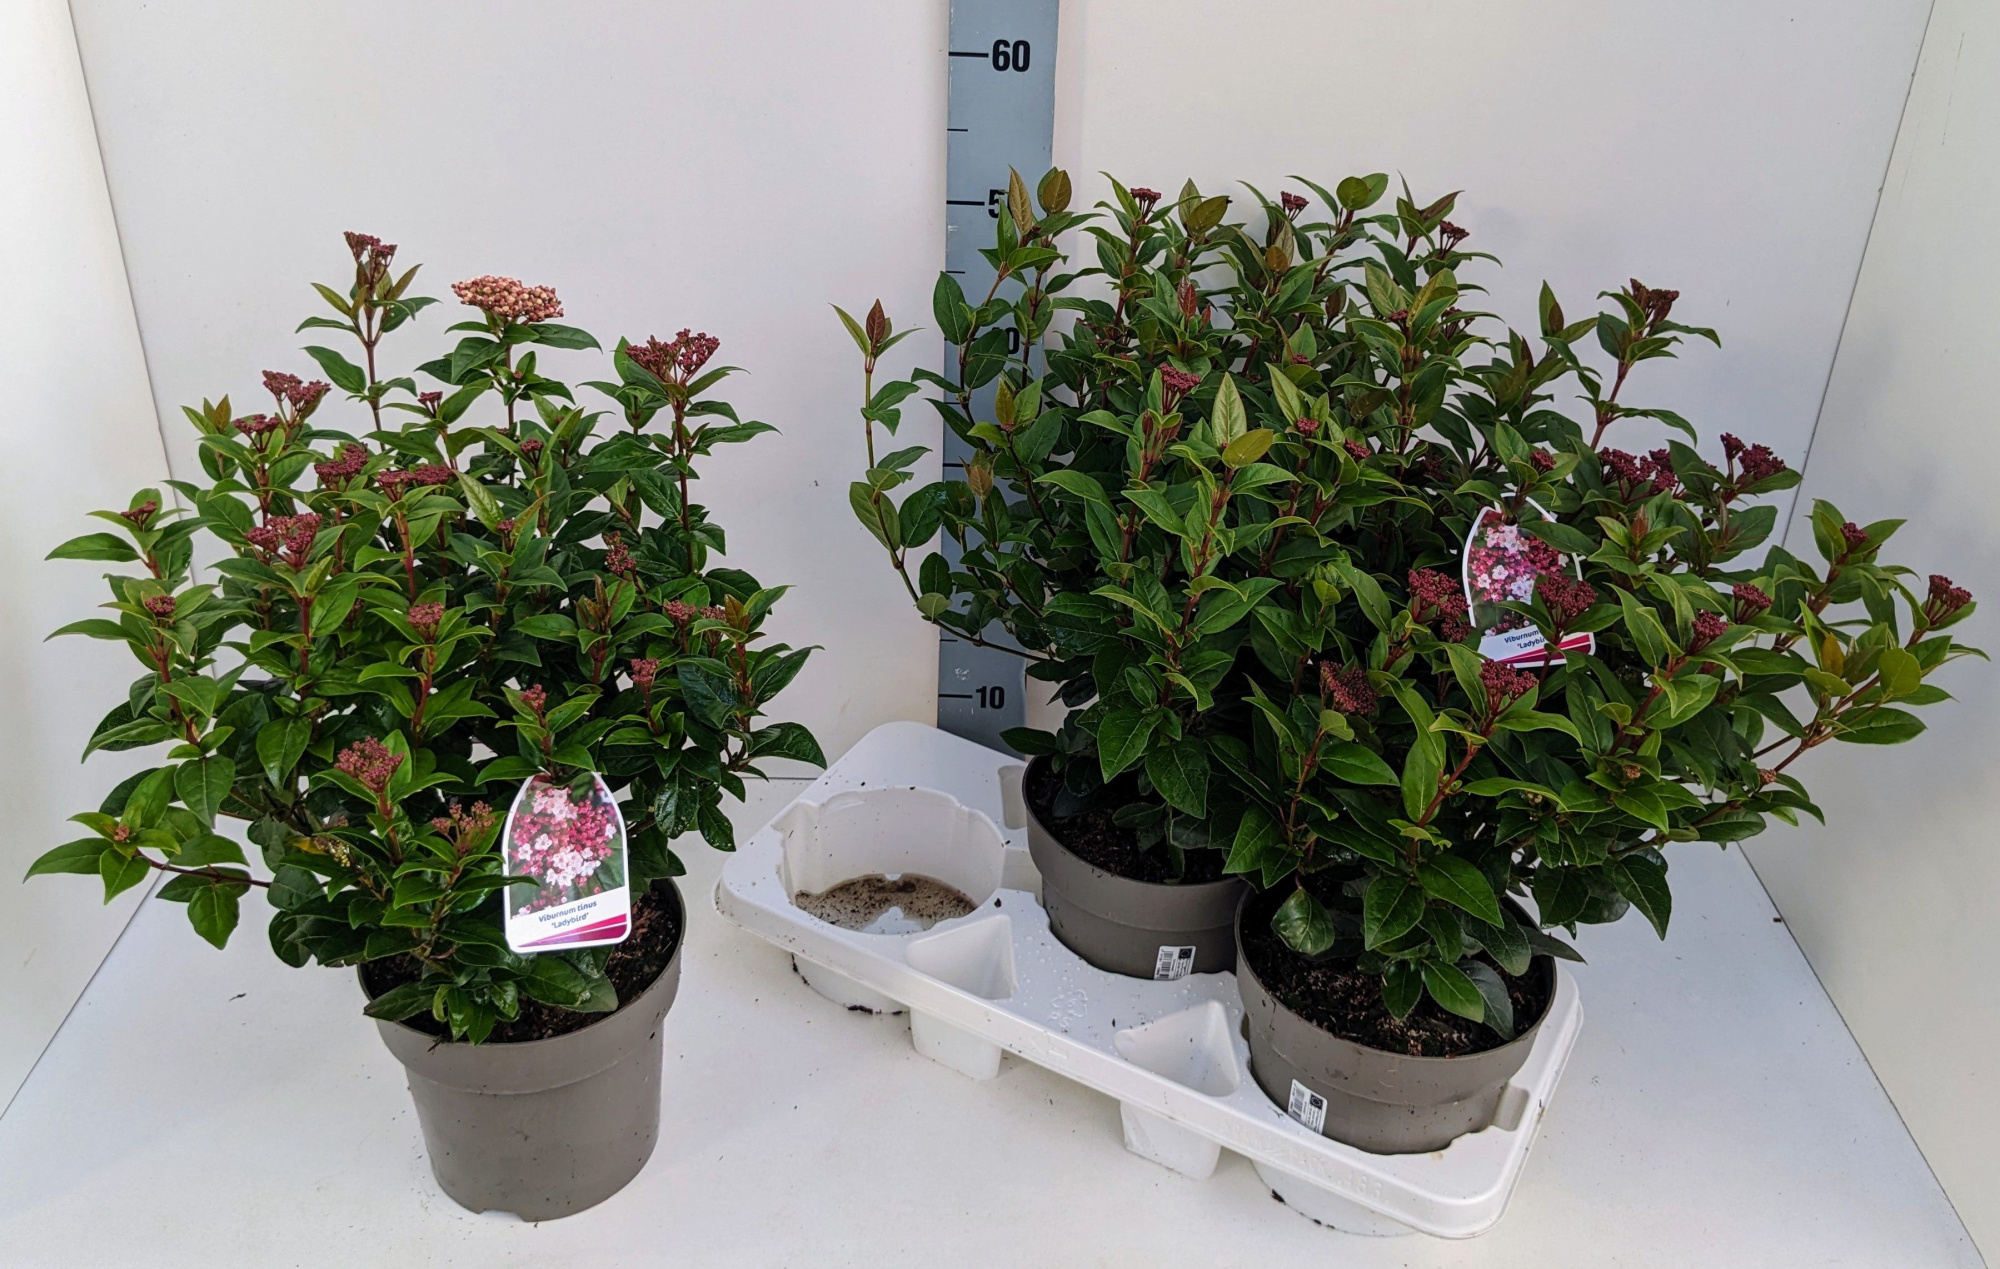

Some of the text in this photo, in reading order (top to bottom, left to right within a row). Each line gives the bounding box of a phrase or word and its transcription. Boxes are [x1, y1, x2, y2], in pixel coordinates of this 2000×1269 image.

[991, 39, 1031, 73] 60
[1504, 629, 1539, 644] Viburnum
[975, 685, 1005, 710] 10
[538, 900, 598, 923] Viburnum tinus
